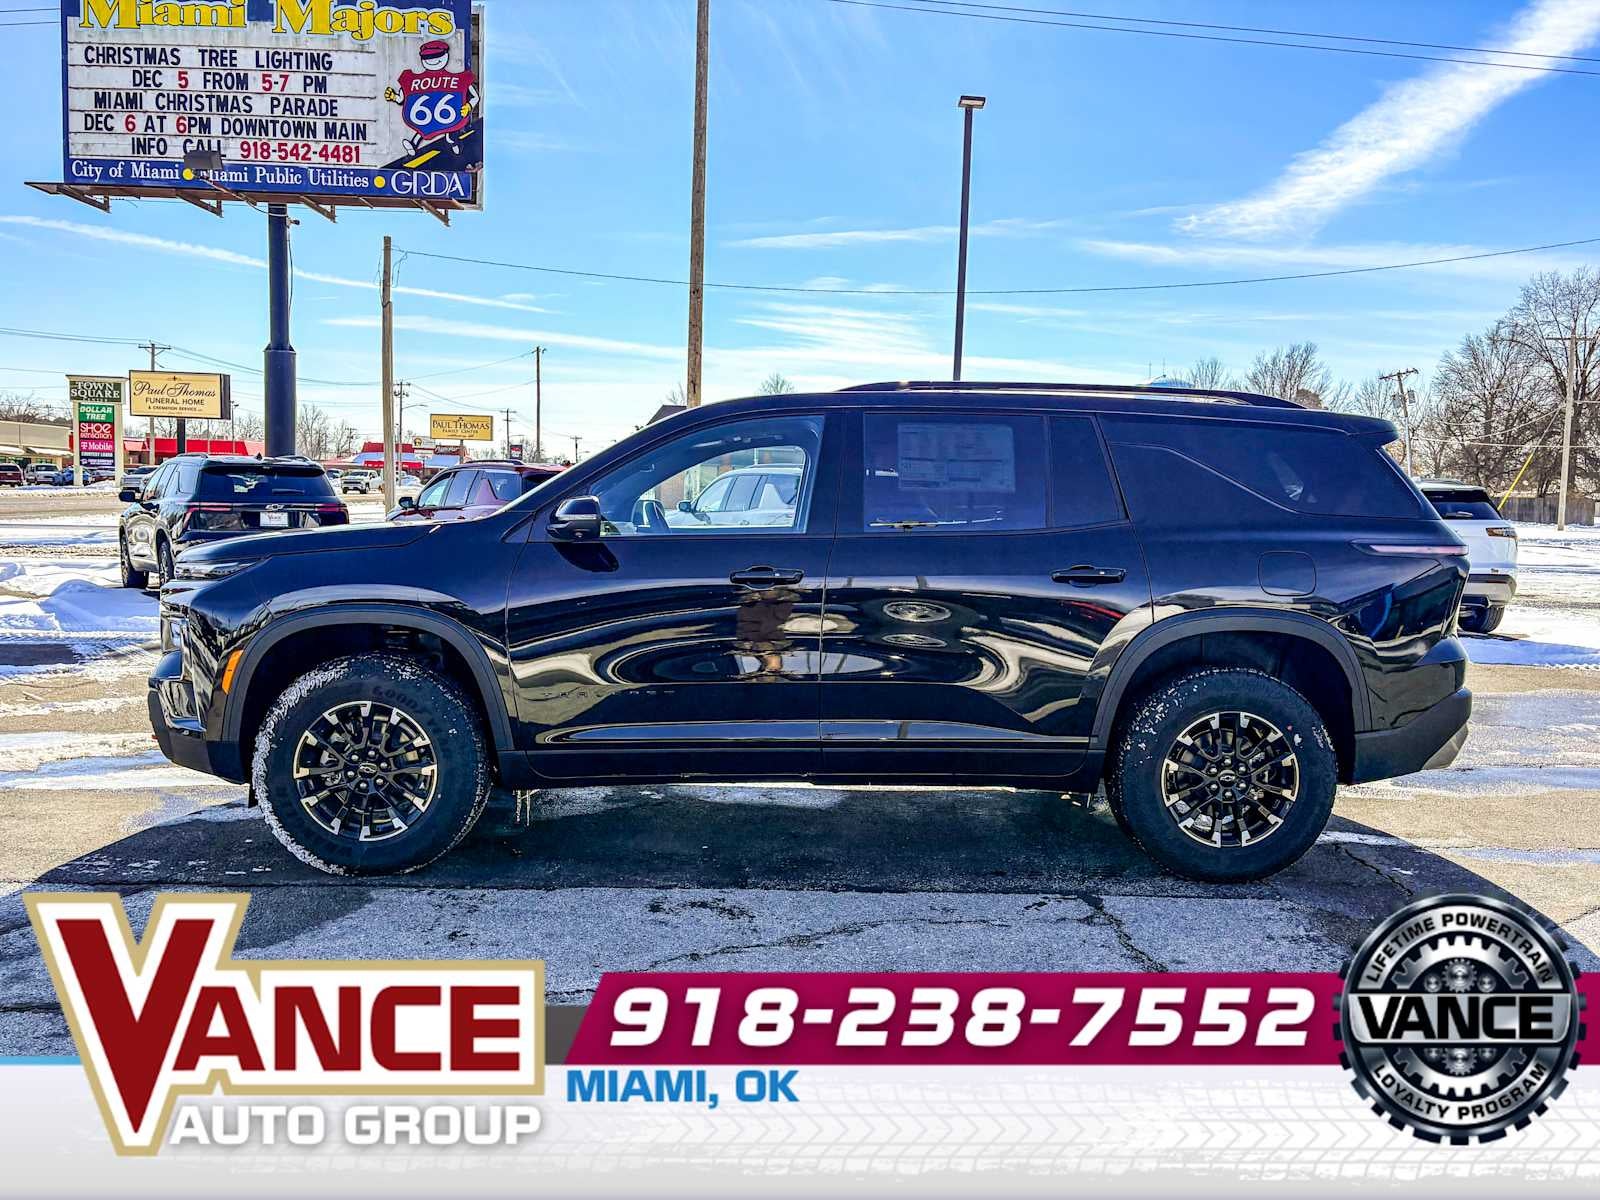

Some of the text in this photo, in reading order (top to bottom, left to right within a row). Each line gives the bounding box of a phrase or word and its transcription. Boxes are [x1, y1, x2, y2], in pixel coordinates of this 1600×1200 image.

[79, 0, 454, 41] Miami Majors
[84, 45, 333, 71] CHRISTMAS TREE LIGHTING
[132, 69, 327, 94] DEC 5 FROM 5-7 PM
[411, 76, 459, 91] ROUTE
[94, 91, 338, 117] MIAMI CHRISTMAS PARADE
[409, 93, 458, 126] 66
[84, 112, 367, 141] DEC 6 AT 6PM DOWNTOWN MAIN
[131, 137, 168, 156] INFO
[240, 140, 361, 164] 918-542-4481
[72, 160, 103, 183] City
[109, 161, 124, 179] of
[131, 163, 179, 180] Miami
[256, 167, 302, 185] Public
[309, 168, 369, 188] Utilities
[391, 170, 465, 196] GRDA
[71, 388, 120, 399] SQUARE
[76, 381, 114, 391] TOWN
[133, 381, 216, 397] Paul Thomas
[80, 405, 113, 414] DOLLAR
[146, 397, 205, 406] FUNERAL HOME
[86, 413, 107, 421] TREE
[432, 420, 490, 430] PAUL THOMAS
